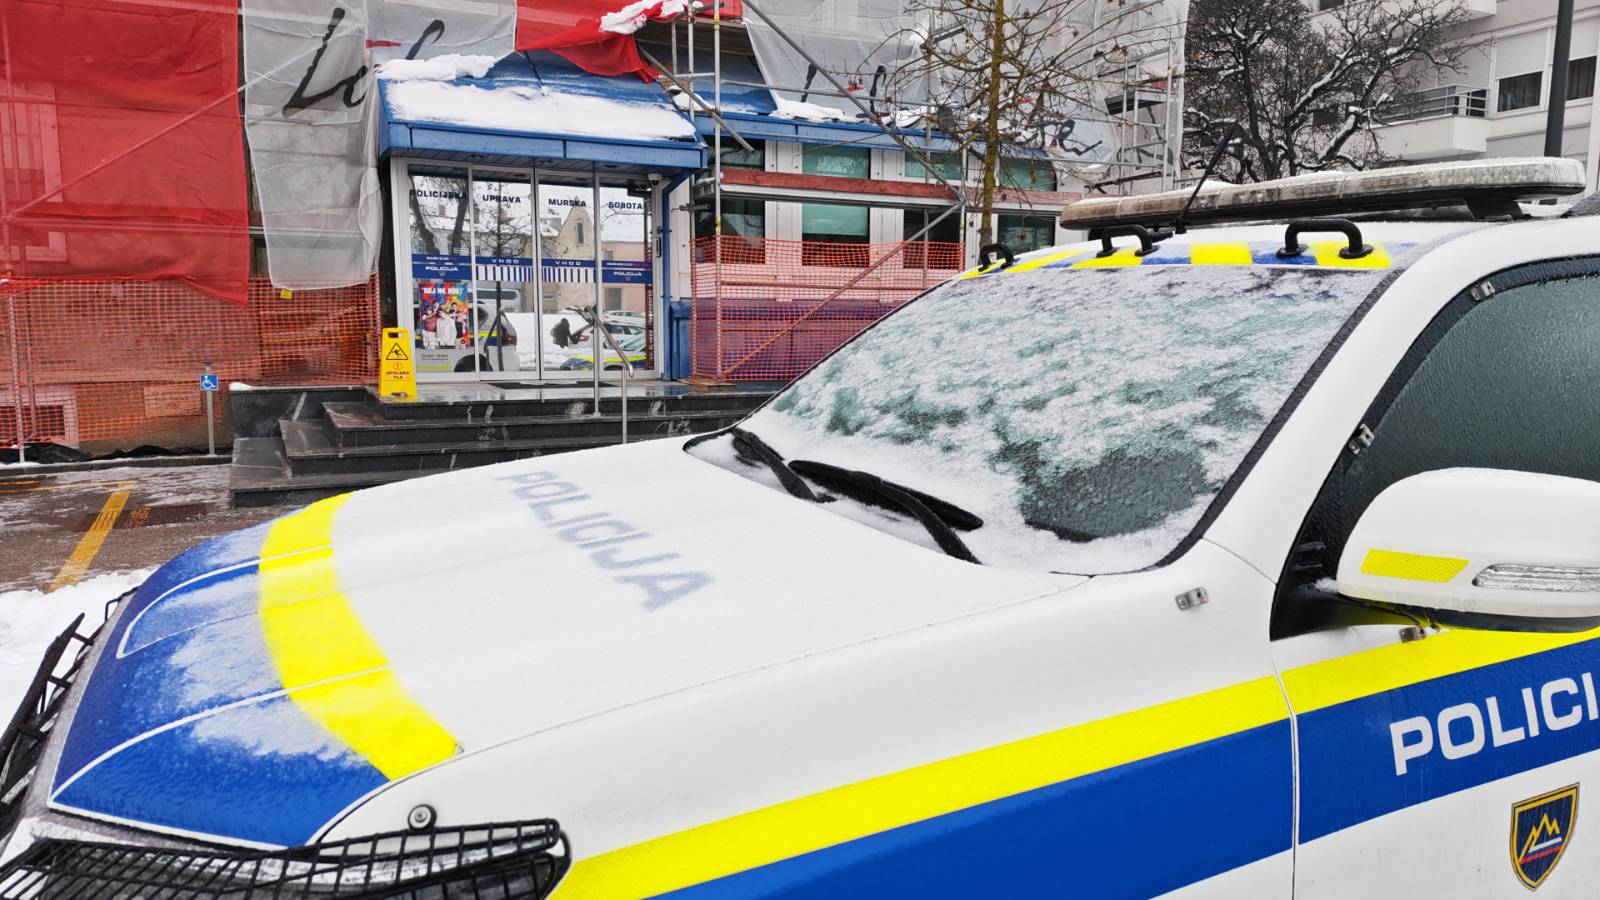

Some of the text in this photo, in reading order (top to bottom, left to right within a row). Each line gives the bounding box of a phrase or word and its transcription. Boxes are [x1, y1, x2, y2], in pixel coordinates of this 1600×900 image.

[482, 194, 521, 203] UPRAVA
[548, 198, 587, 207] MURSKA
[608, 201, 643, 210] SOBOTA
[494, 470, 714, 613] POLICIJA
[1389, 672, 1600, 776] POLICI
